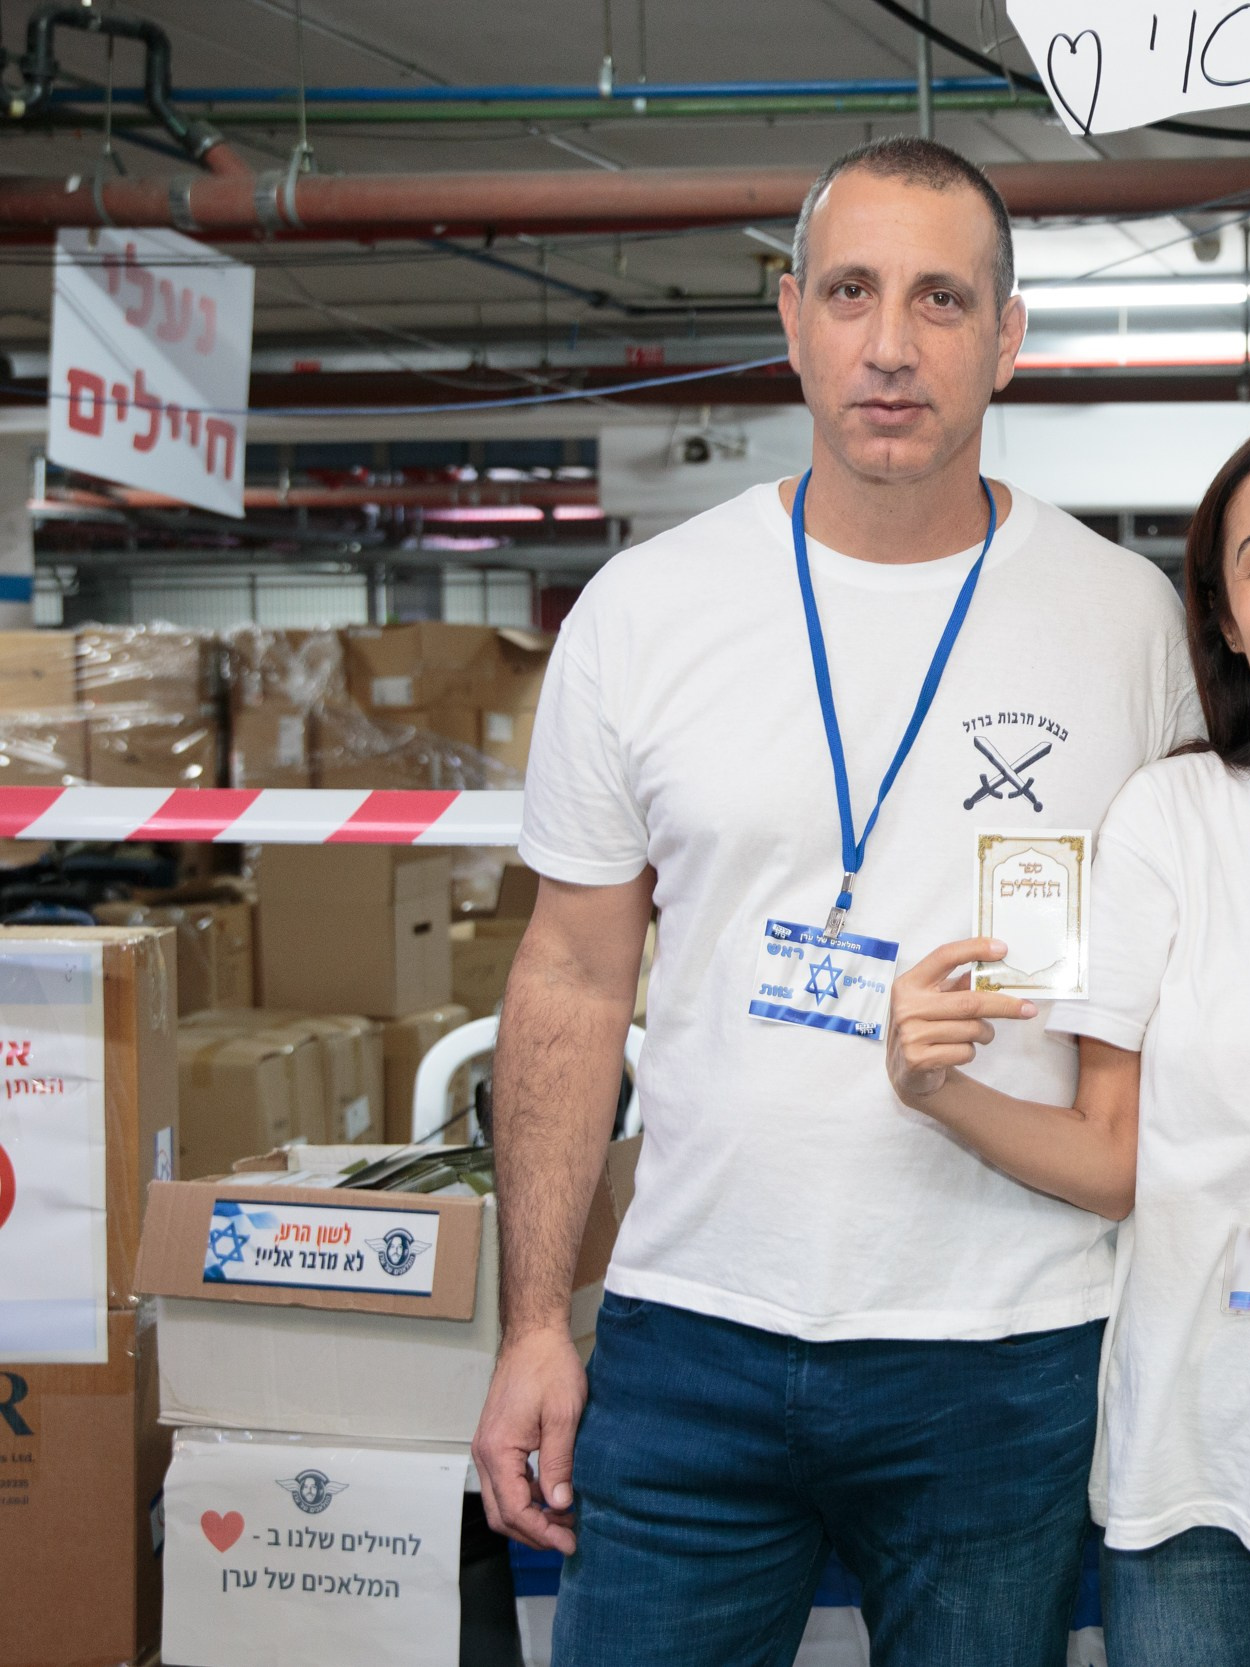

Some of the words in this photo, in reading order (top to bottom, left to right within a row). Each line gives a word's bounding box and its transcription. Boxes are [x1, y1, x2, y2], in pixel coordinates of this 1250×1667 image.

[66, 367, 238, 481] חיילים
[962, 714, 993, 733] ברזל
[997, 711, 1034, 726] חרבות
[1019, 862, 1043, 874] ספר
[1000, 877, 1061, 898] תהלים
[816, 935, 828, 945] של
[830, 938, 862, 951] המלאכים
[767, 943, 804, 960] ראש
[316, 1221, 351, 1253] לשון
[300, 1249, 338, 1271] מדבר
[344, 1250, 364, 1272] לא
[288, 1526, 335, 1551] שלנו
[342, 1530, 422, 1557] לחיילים
[222, 1567, 258, 1592] ערן
[264, 1566, 296, 1591] של
[302, 1573, 400, 1598] המלאכים
